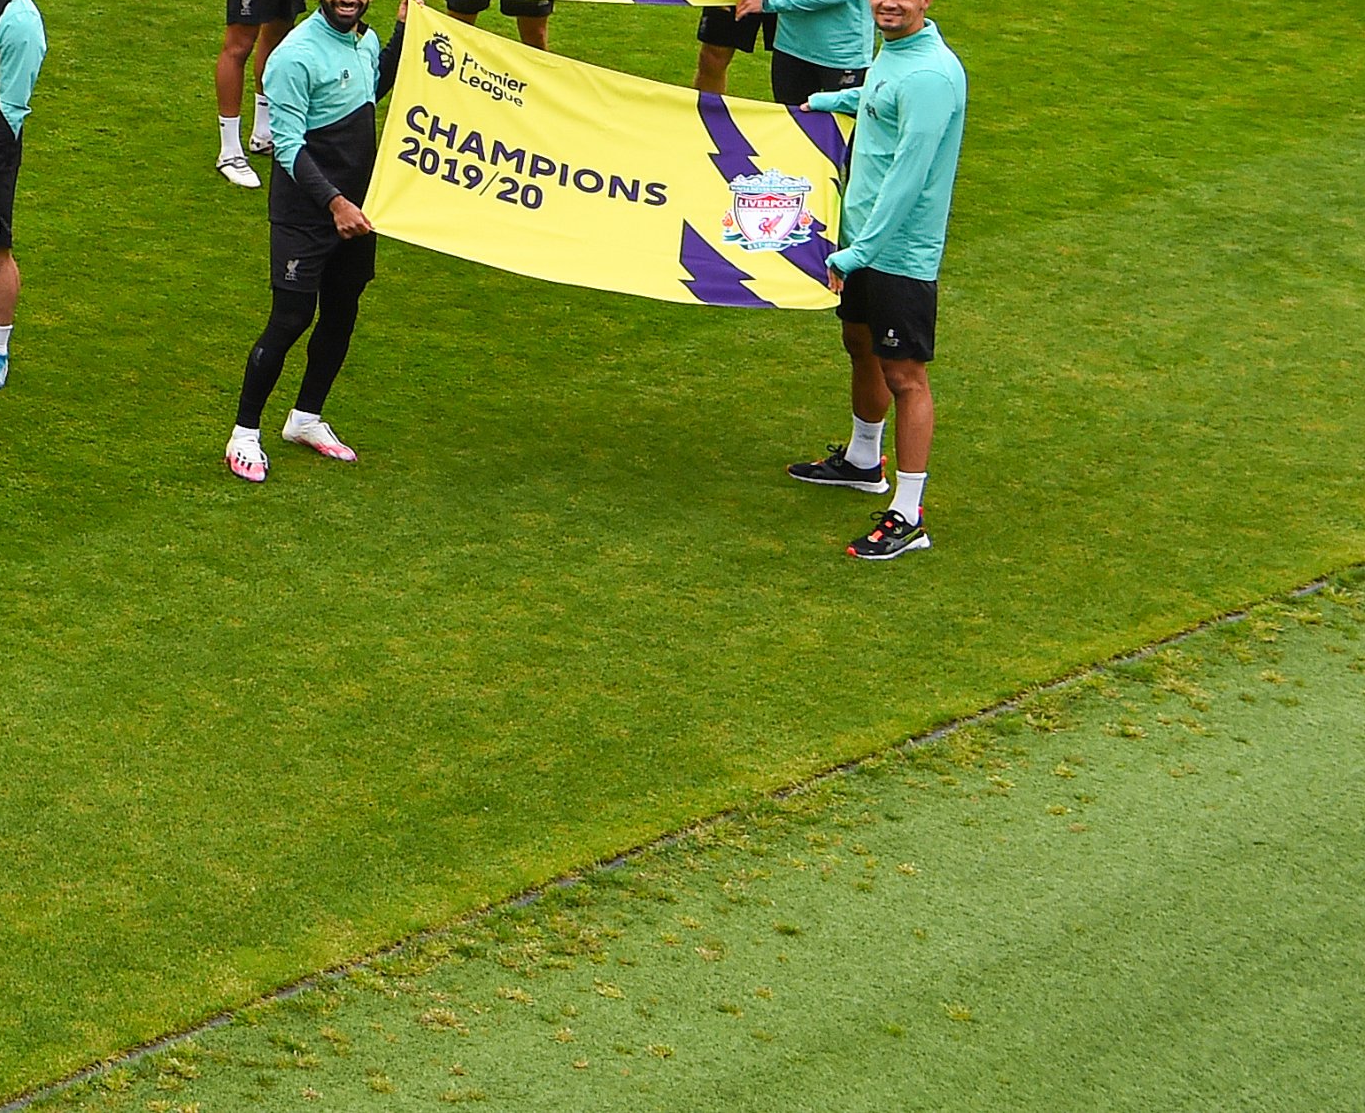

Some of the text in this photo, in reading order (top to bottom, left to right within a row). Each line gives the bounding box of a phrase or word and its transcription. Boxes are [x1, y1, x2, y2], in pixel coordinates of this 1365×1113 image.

[460, 68, 522, 106] League
[463, 53, 527, 93] Premier
[398, 138, 542, 209] 2019/20
[406, 106, 667, 206] CHAMPIONS
[738, 199, 798, 208] LIVERPOOL
